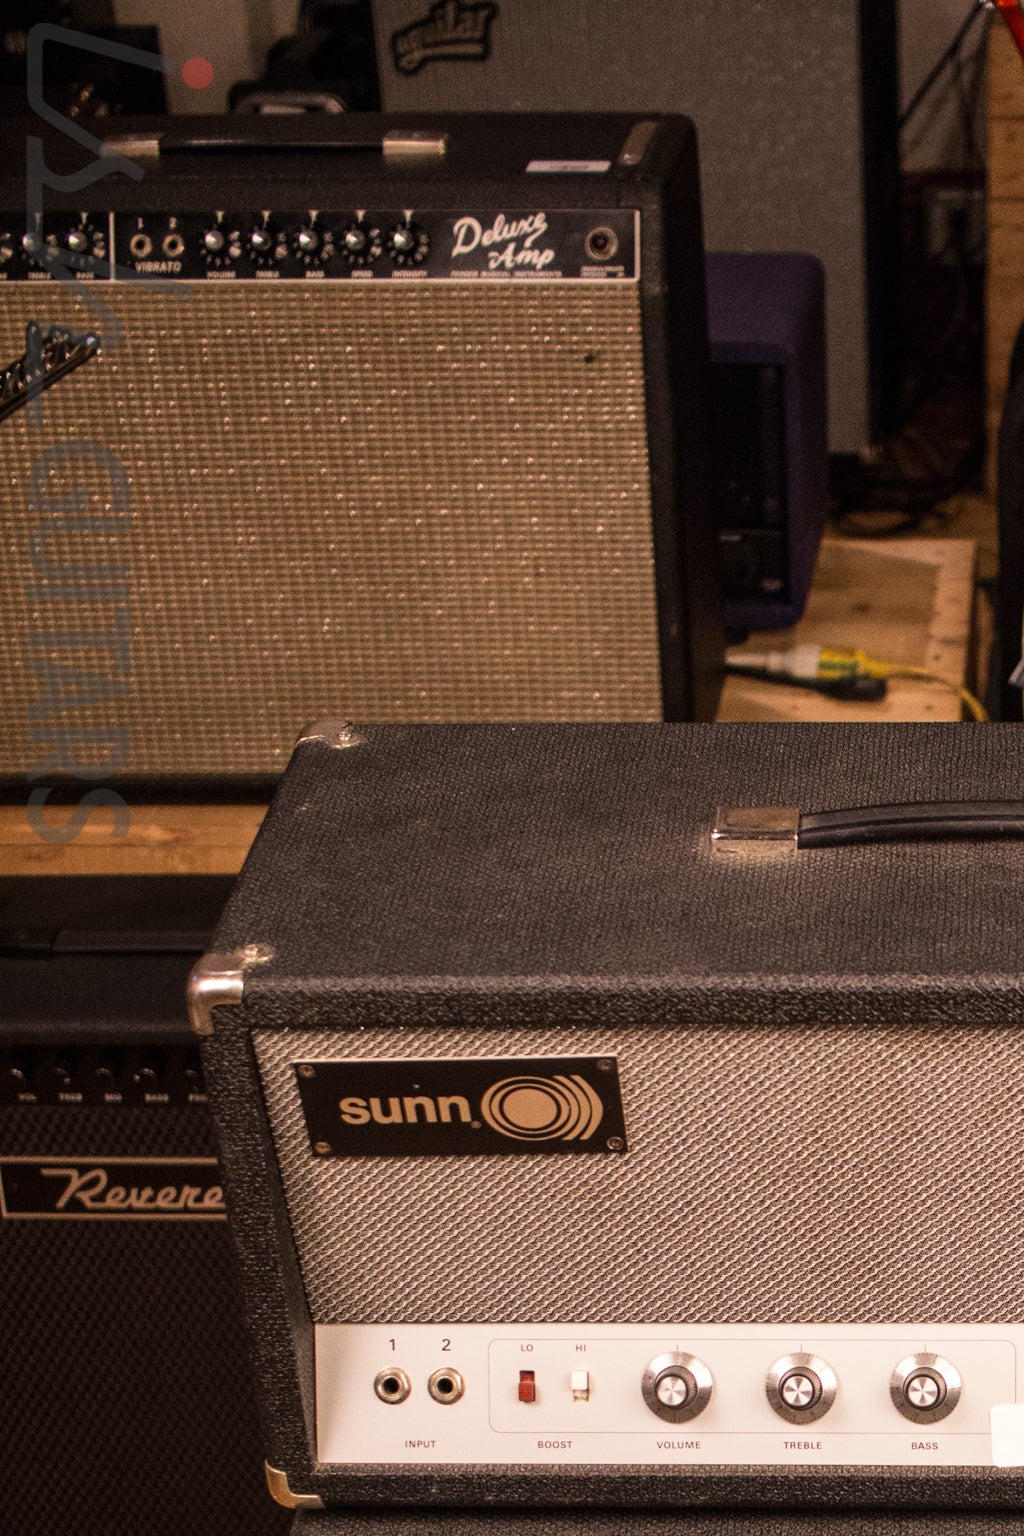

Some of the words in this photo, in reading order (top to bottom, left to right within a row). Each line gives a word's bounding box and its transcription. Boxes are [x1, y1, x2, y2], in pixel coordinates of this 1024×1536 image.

[137, 217, 144, 230] 1
[169, 217, 177, 230] 2
[451, 212, 548, 258] Deluxe
[487, 242, 556, 270] Amp
[135, 261, 182, 274] VIBRATO
[339, 1095, 472, 1125] sunn
[387, 1338, 396, 1352] 1
[441, 1338, 452, 1352] 2
[520, 1343, 534, 1353] LO
[575, 1343, 587, 1353] HI
[404, 1439, 437, 1449] INPUT
[537, 1440, 573, 1450] BOOST
[656, 1440, 701, 1450] VOLUME
[783, 1440, 823, 1450] TREBLE
[911, 1441, 939, 1451] BASS
